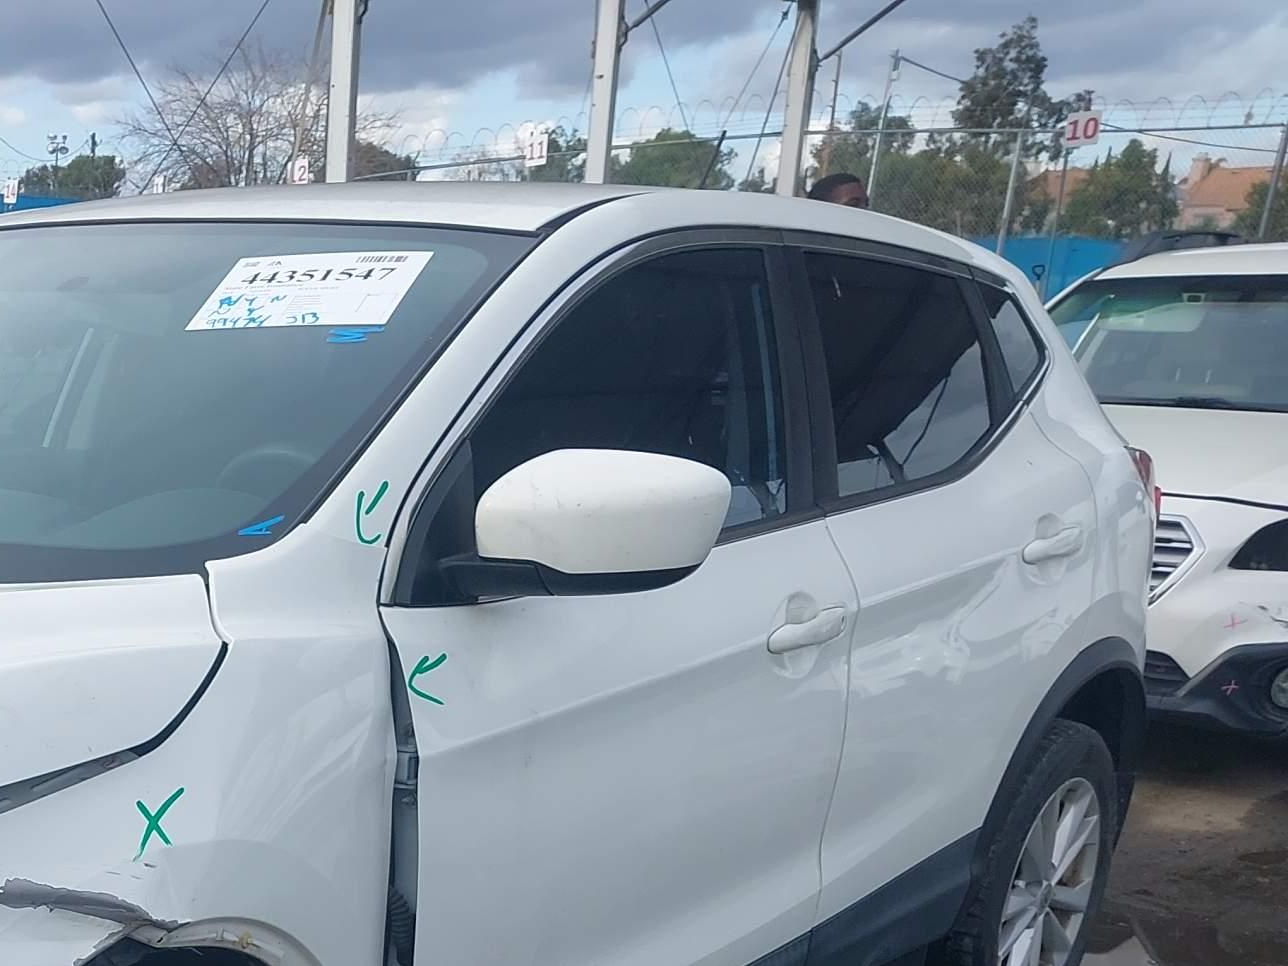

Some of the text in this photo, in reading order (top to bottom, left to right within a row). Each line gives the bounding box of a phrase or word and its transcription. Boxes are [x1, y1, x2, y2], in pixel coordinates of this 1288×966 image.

[1066, 117, 1099, 142] 10
[527, 141, 545, 161] 11
[241, 267, 398, 285] 44351547
